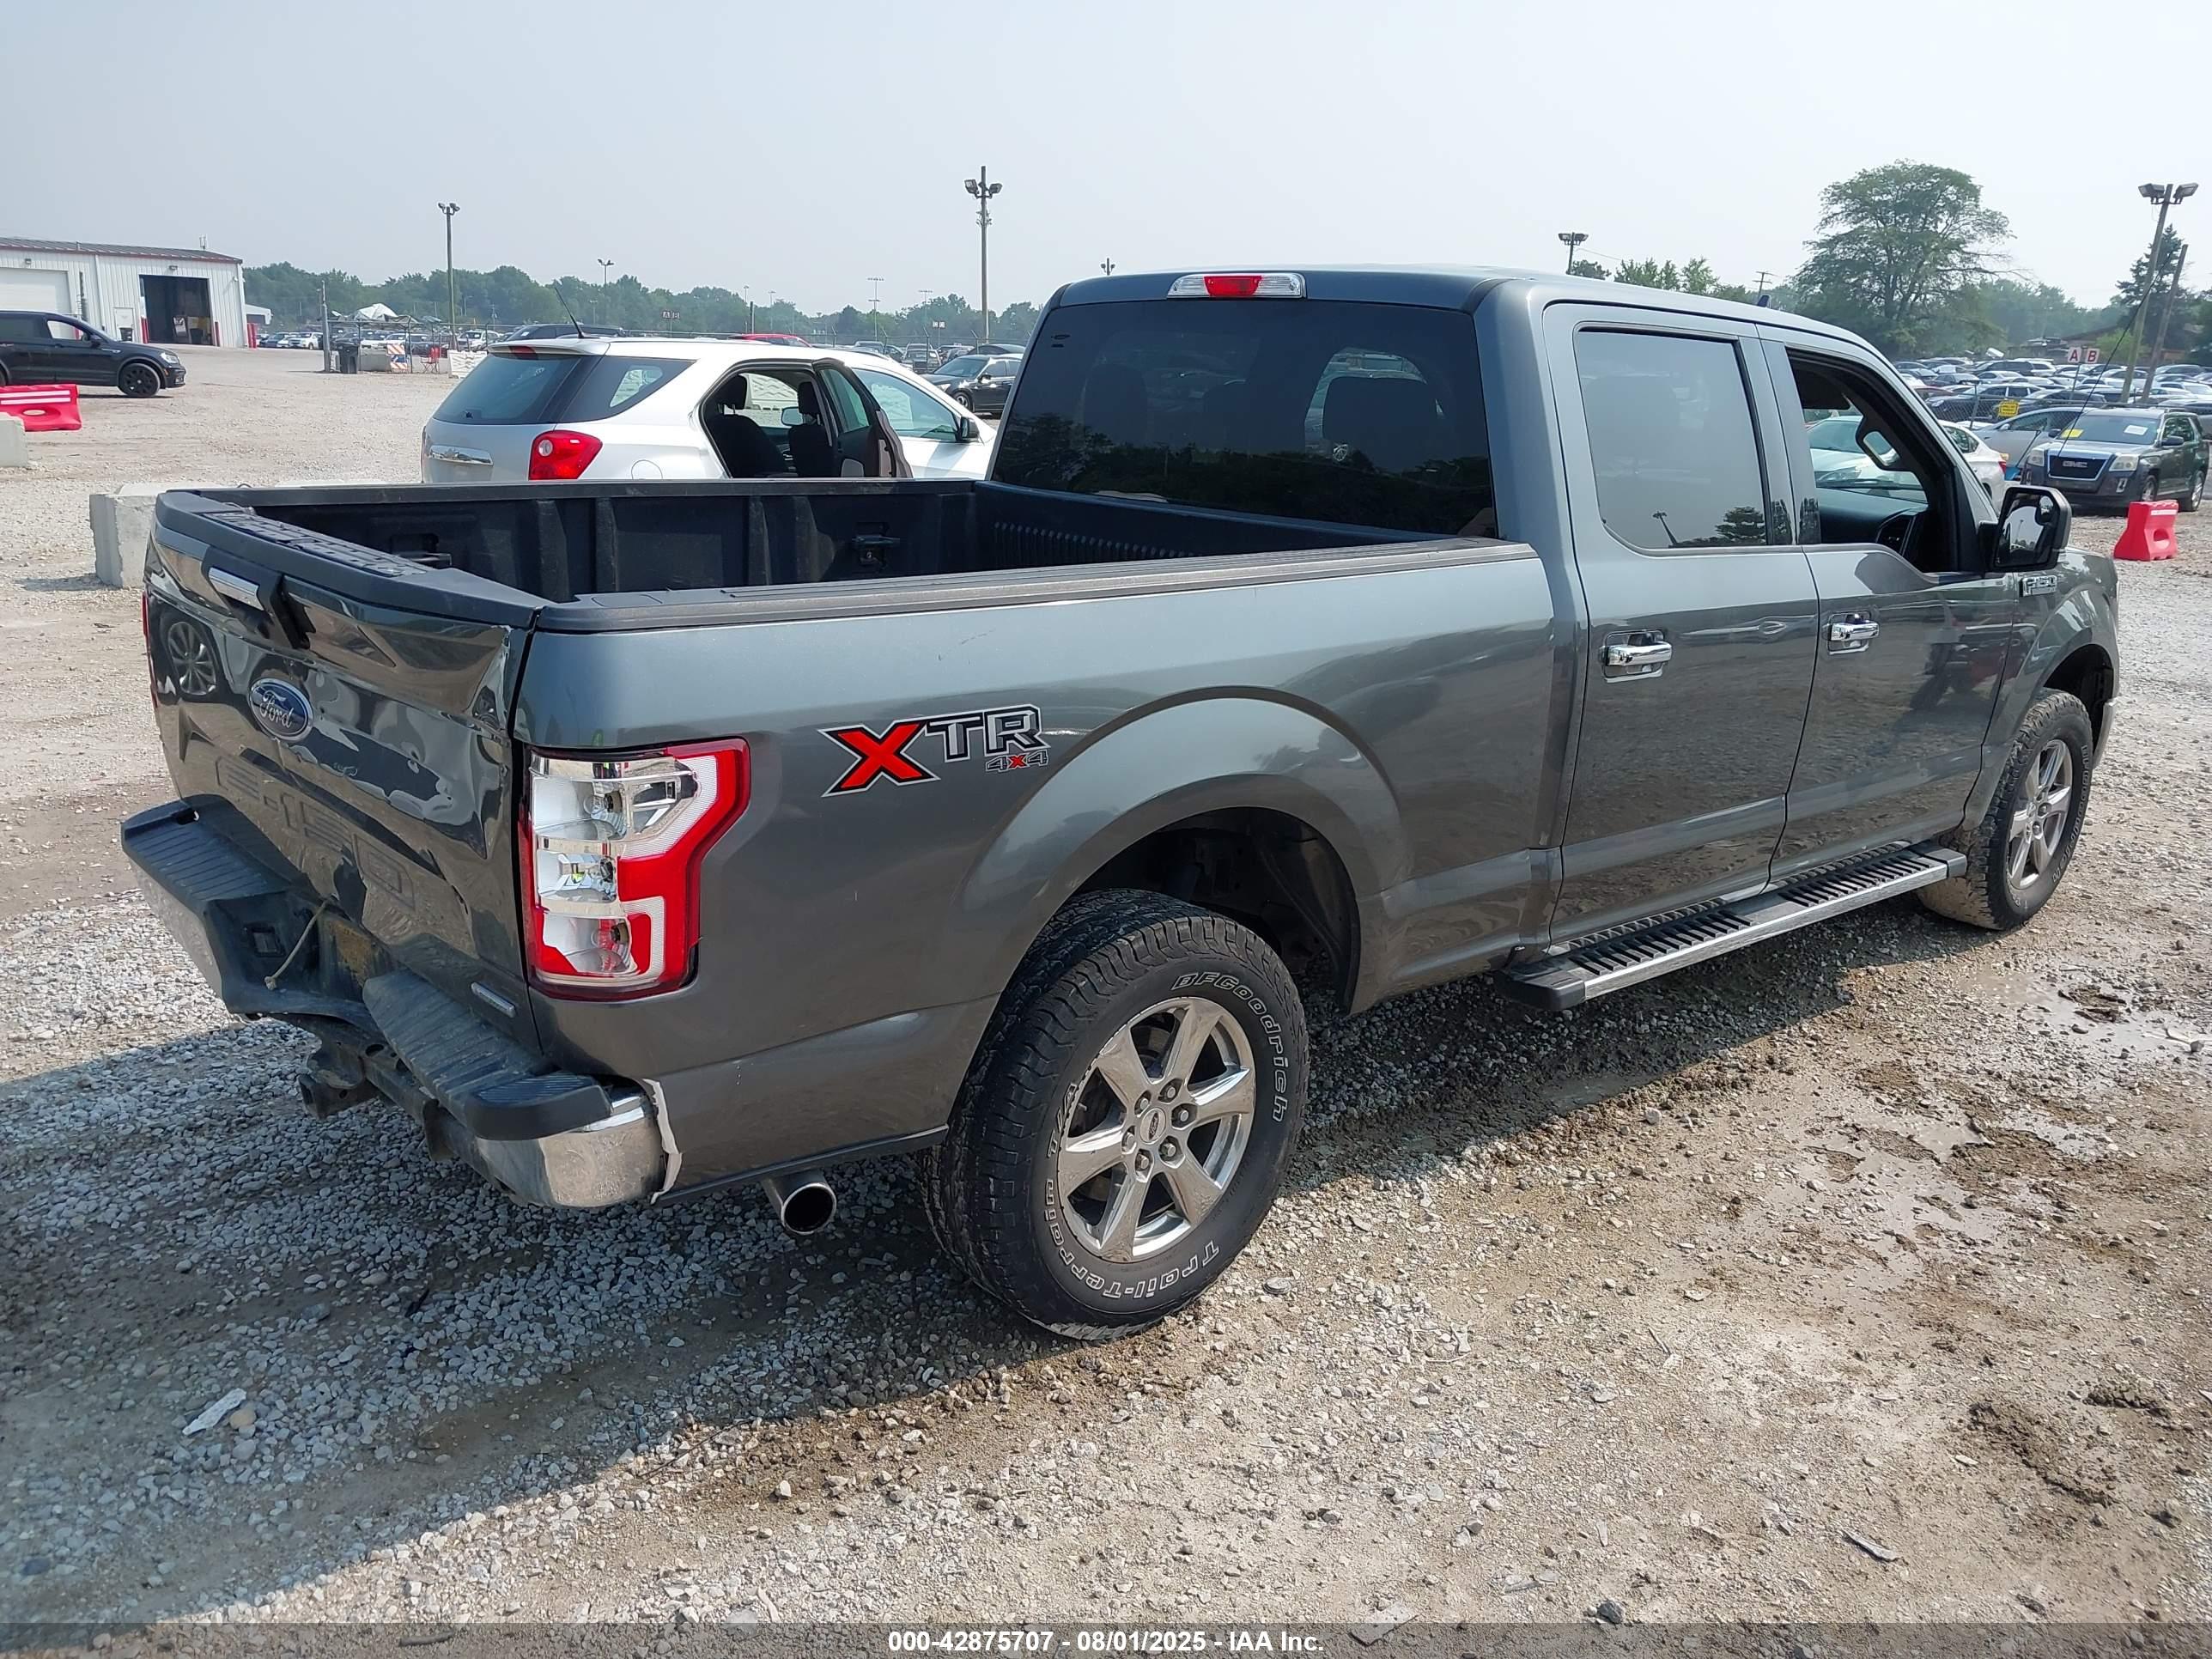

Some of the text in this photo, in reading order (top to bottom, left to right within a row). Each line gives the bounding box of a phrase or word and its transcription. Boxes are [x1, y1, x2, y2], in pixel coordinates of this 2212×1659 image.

[2069, 349, 2079, 362] A
[2087, 349, 2098, 362] B
[260, 690, 295, 728] Ford
[817, 703, 1051, 798] XTR
[1171, 972, 1288, 1122] BFGoodrich
[1044, 1179, 1220, 1300] Trail-Terrain
